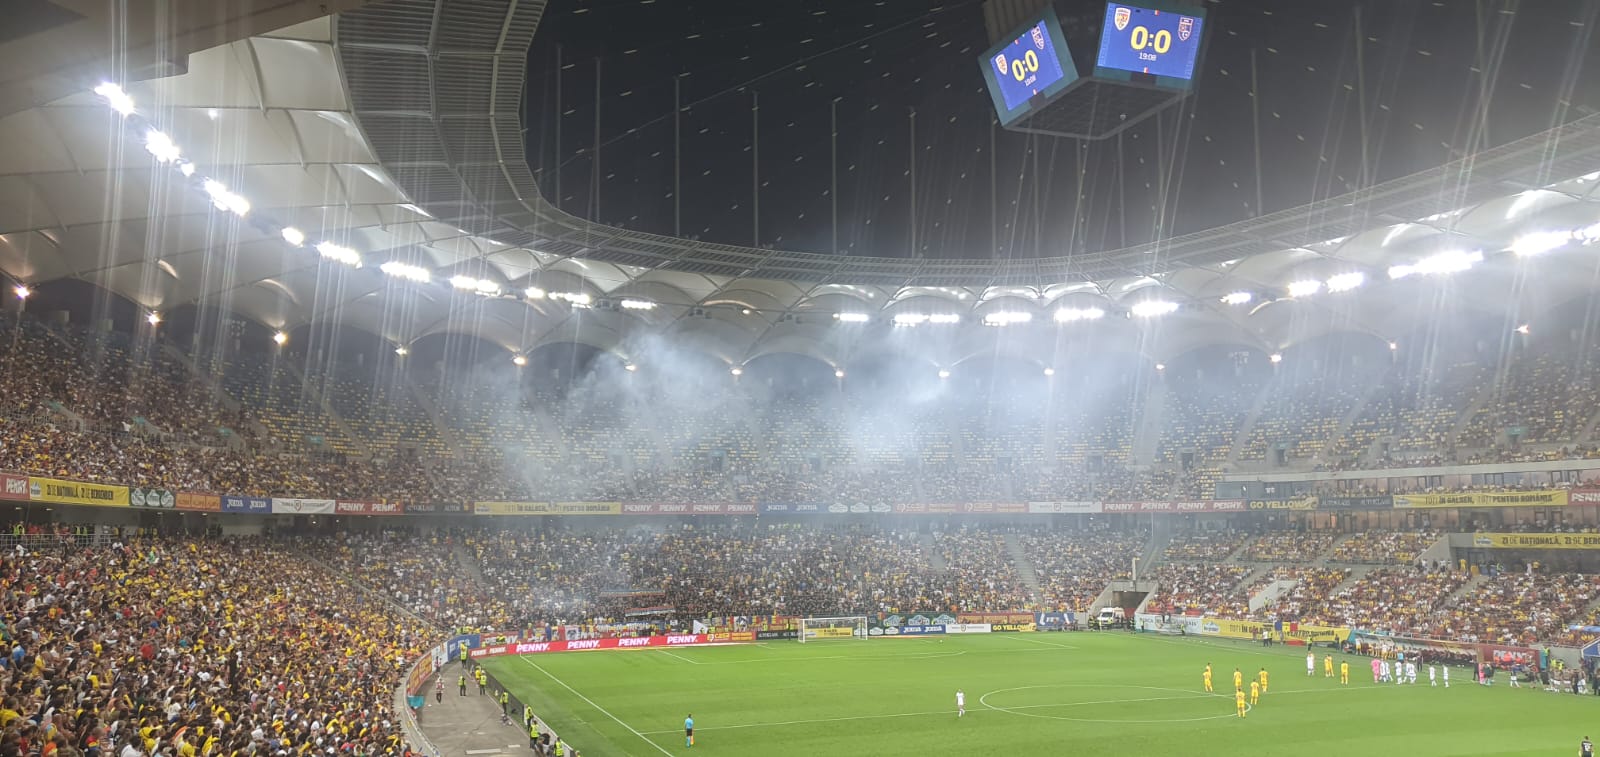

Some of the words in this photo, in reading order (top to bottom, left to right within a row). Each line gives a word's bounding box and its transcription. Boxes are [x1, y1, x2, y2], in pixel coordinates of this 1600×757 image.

[1130, 25, 1171, 54] 0:0
[1012, 50, 1039, 82] 0:0
[1139, 52, 1157, 61] 19:08
[1250, 501, 1263, 509] GO
